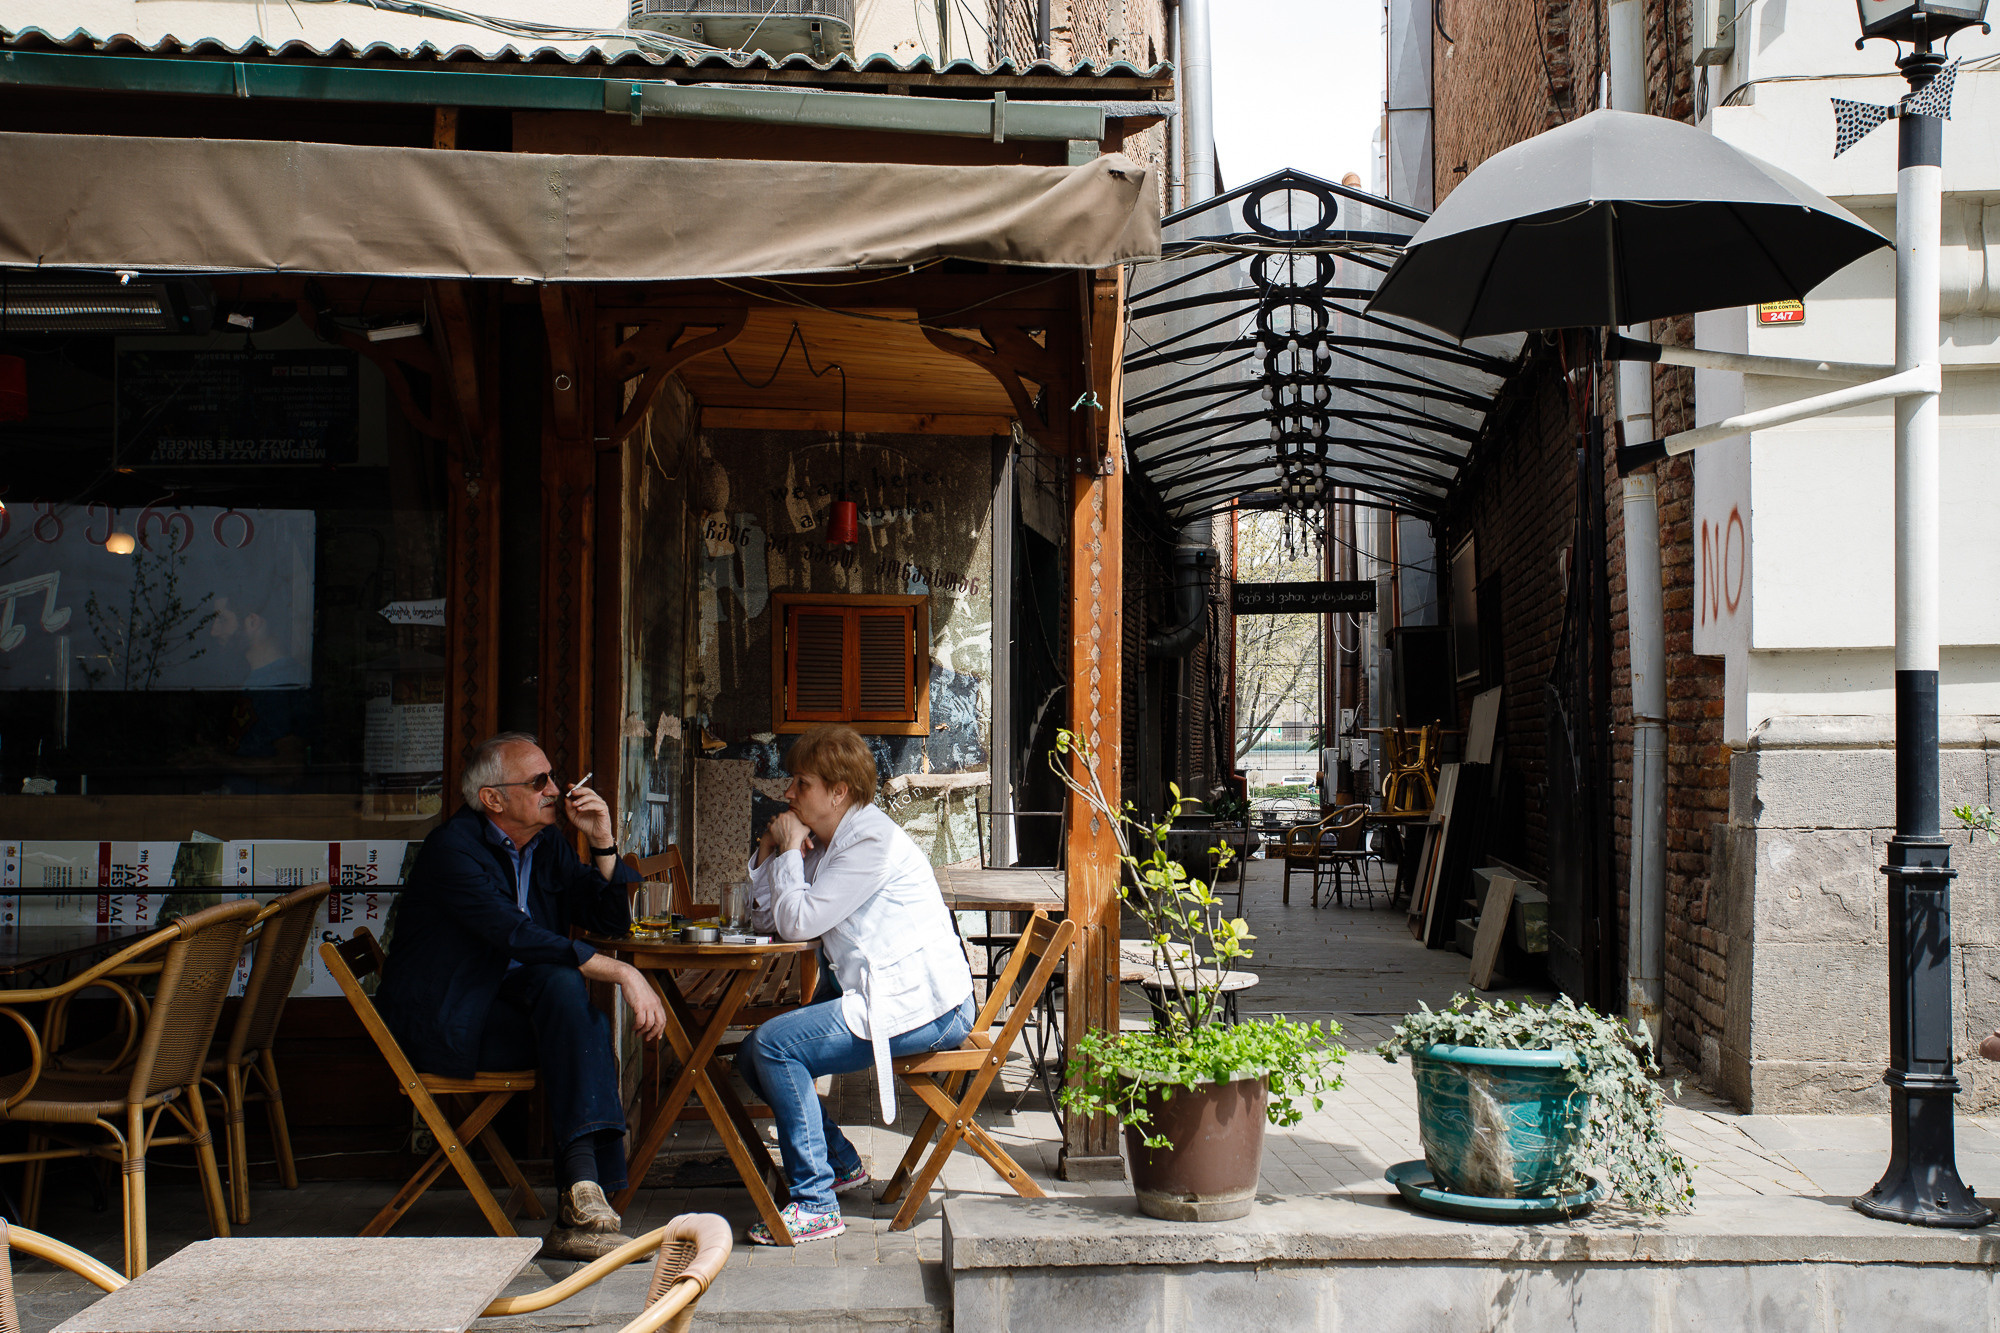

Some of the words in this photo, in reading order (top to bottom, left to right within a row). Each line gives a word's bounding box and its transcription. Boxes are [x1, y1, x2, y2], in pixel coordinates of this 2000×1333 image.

[1770, 311, 1794, 321] 24/7
[157, 439, 214, 450] SINGER
[259, 439, 296, 450] JAZZ
[296, 439, 318, 450] AT
[150, 448, 184, 460] 2017
[186, 448, 225, 460] FEST
[227, 448, 266, 460] JAZZ
[268, 448, 326, 459] MEIDAN
[769, 485, 806, 504] we
[1700, 503, 1745, 627] NO
[1238, 592, 1261, 605] ჩვენ
[140, 850, 149, 863] 9th
[369, 849, 377, 863] 9th
[110, 864, 123, 924] FESVAL
[136, 864, 149, 921] KAKAZ
[341, 864, 353, 924] FESIVAL
[366, 864, 378, 920] KAKAZ
